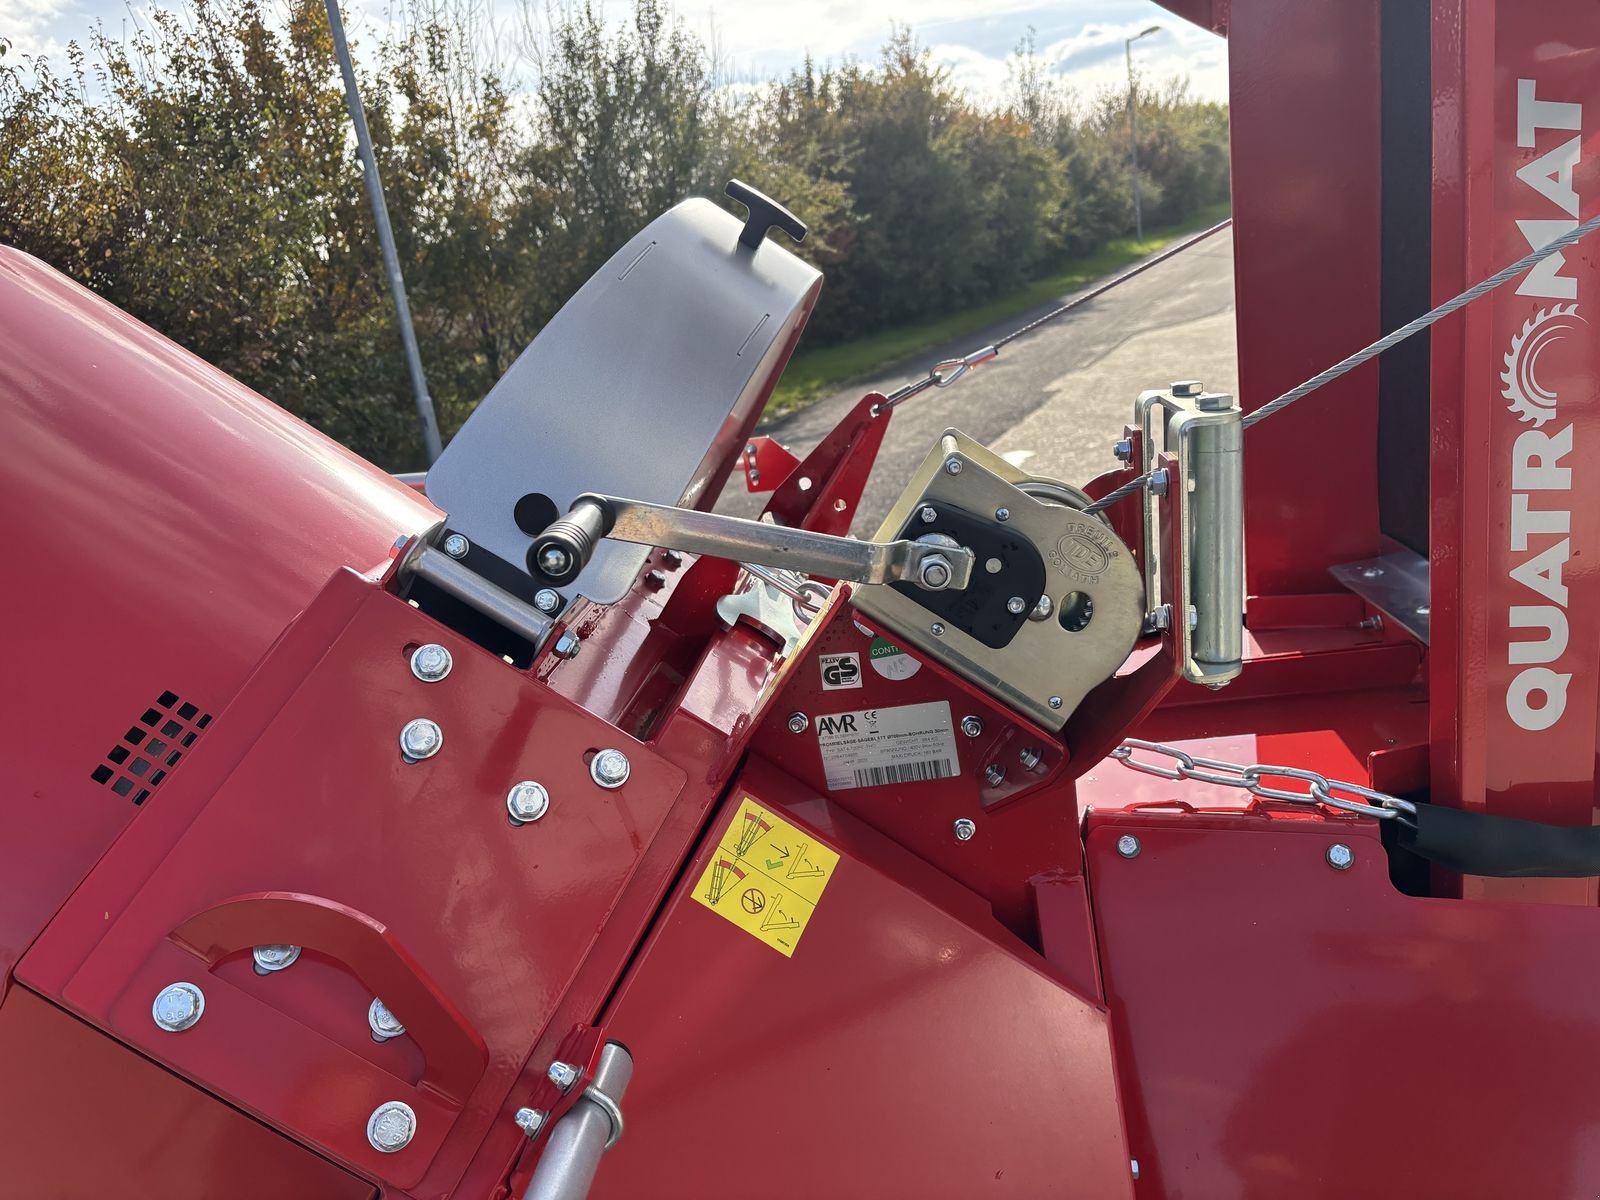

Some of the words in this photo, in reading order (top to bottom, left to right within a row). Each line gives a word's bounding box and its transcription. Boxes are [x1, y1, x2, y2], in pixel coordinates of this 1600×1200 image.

[1048, 549, 1100, 585] GOLIATH
[823, 657, 858, 685] GS
[817, 714, 858, 736] AMR
